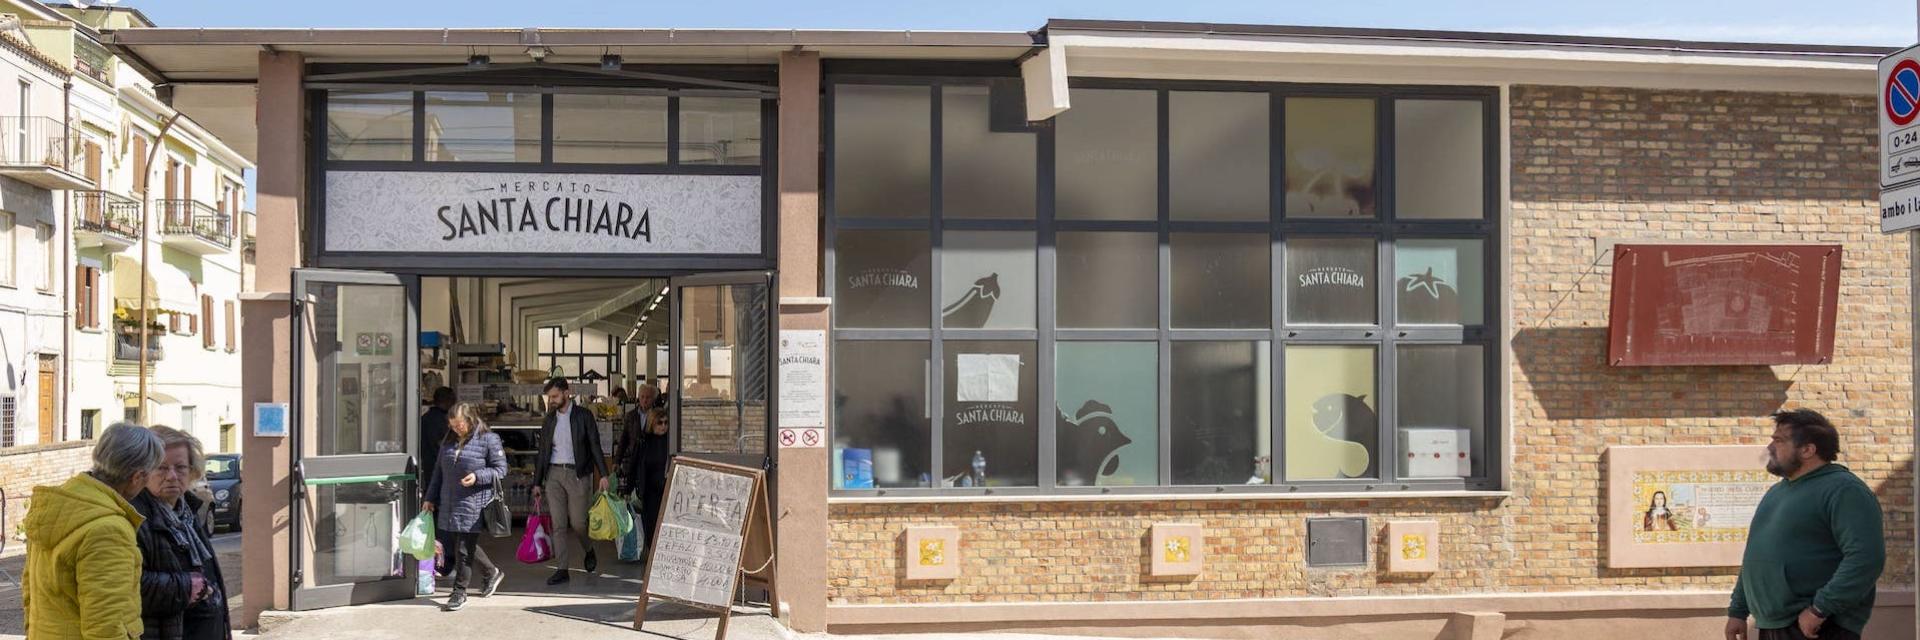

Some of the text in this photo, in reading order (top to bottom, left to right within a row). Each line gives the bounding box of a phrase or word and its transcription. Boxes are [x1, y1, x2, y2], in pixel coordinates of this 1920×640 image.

[1894, 131, 1917, 148] 0-24
[500, 181, 592, 193] MERCATO
[1882, 201, 1905, 219] ambo
[1908, 197, 1911, 214] i
[437, 197, 651, 243] SANTA CHIARA
[849, 272, 918, 289] SANTA CHIARA
[1299, 271, 1364, 289] SANTA CHIARA
[956, 408, 1024, 425] SANTA CHIARA
